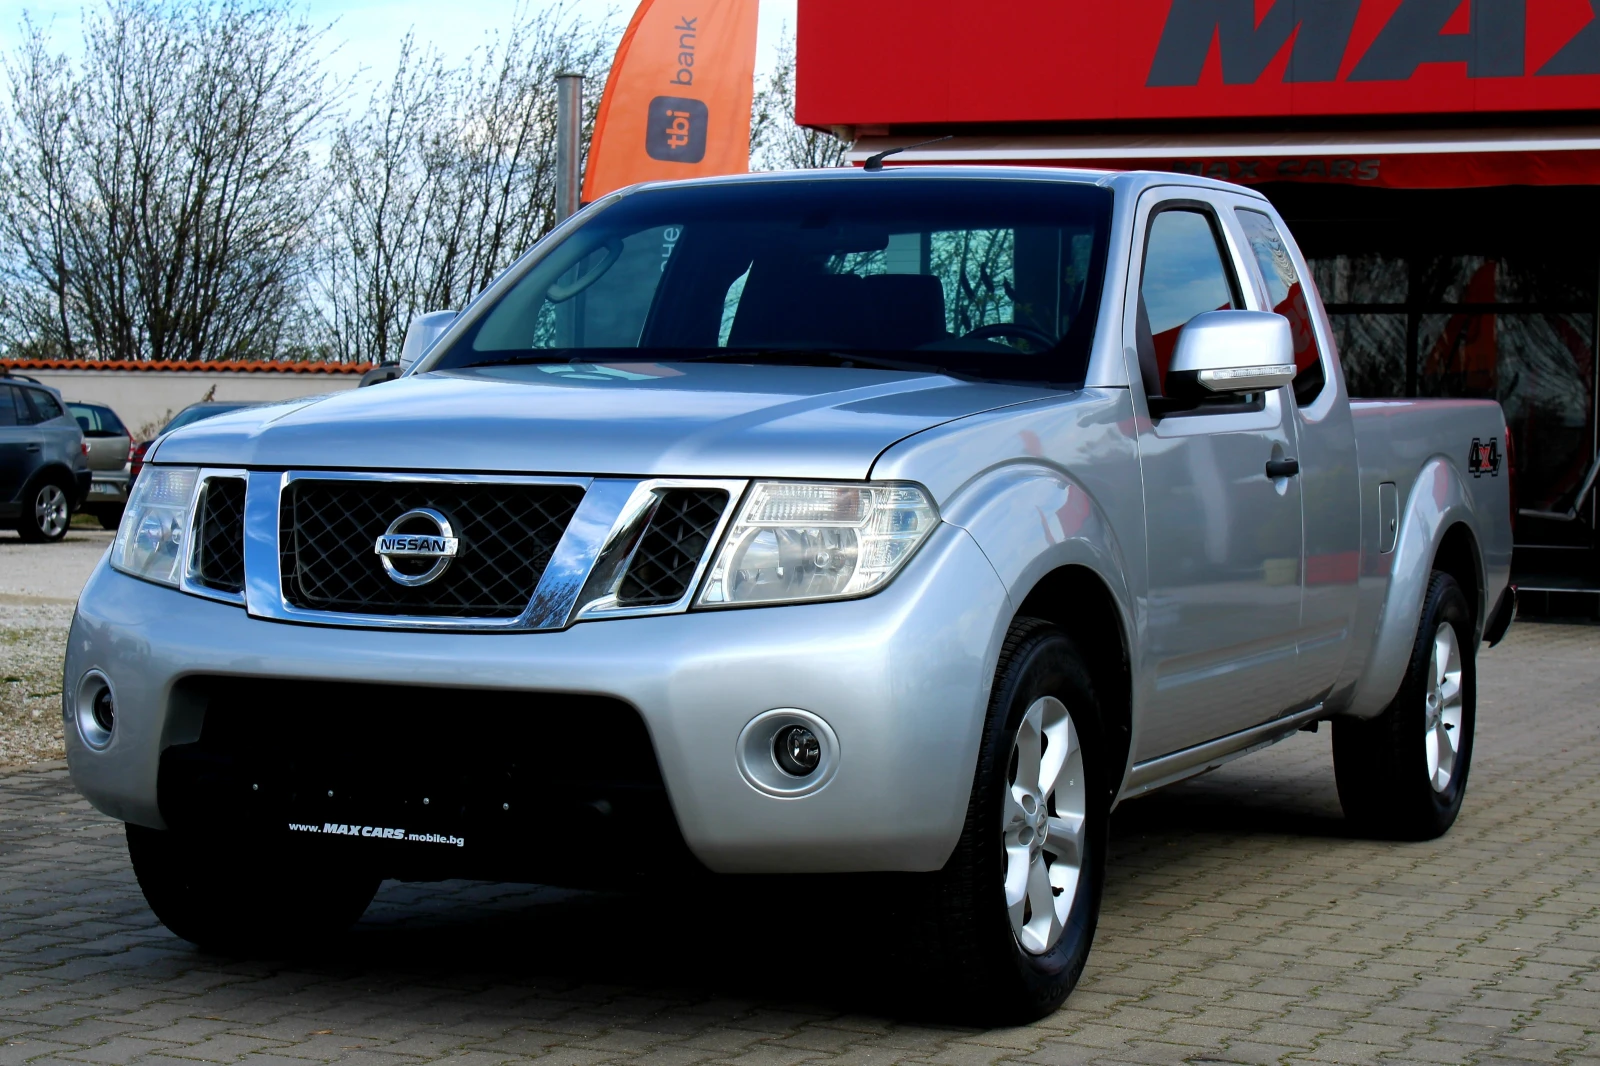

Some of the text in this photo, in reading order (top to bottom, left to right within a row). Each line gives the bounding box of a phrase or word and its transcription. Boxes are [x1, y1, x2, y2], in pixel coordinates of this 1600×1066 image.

[666, 16, 698, 149] tbi bank
[1277, 159, 1381, 181] CARS
[380, 538, 446, 552] NISSAN
